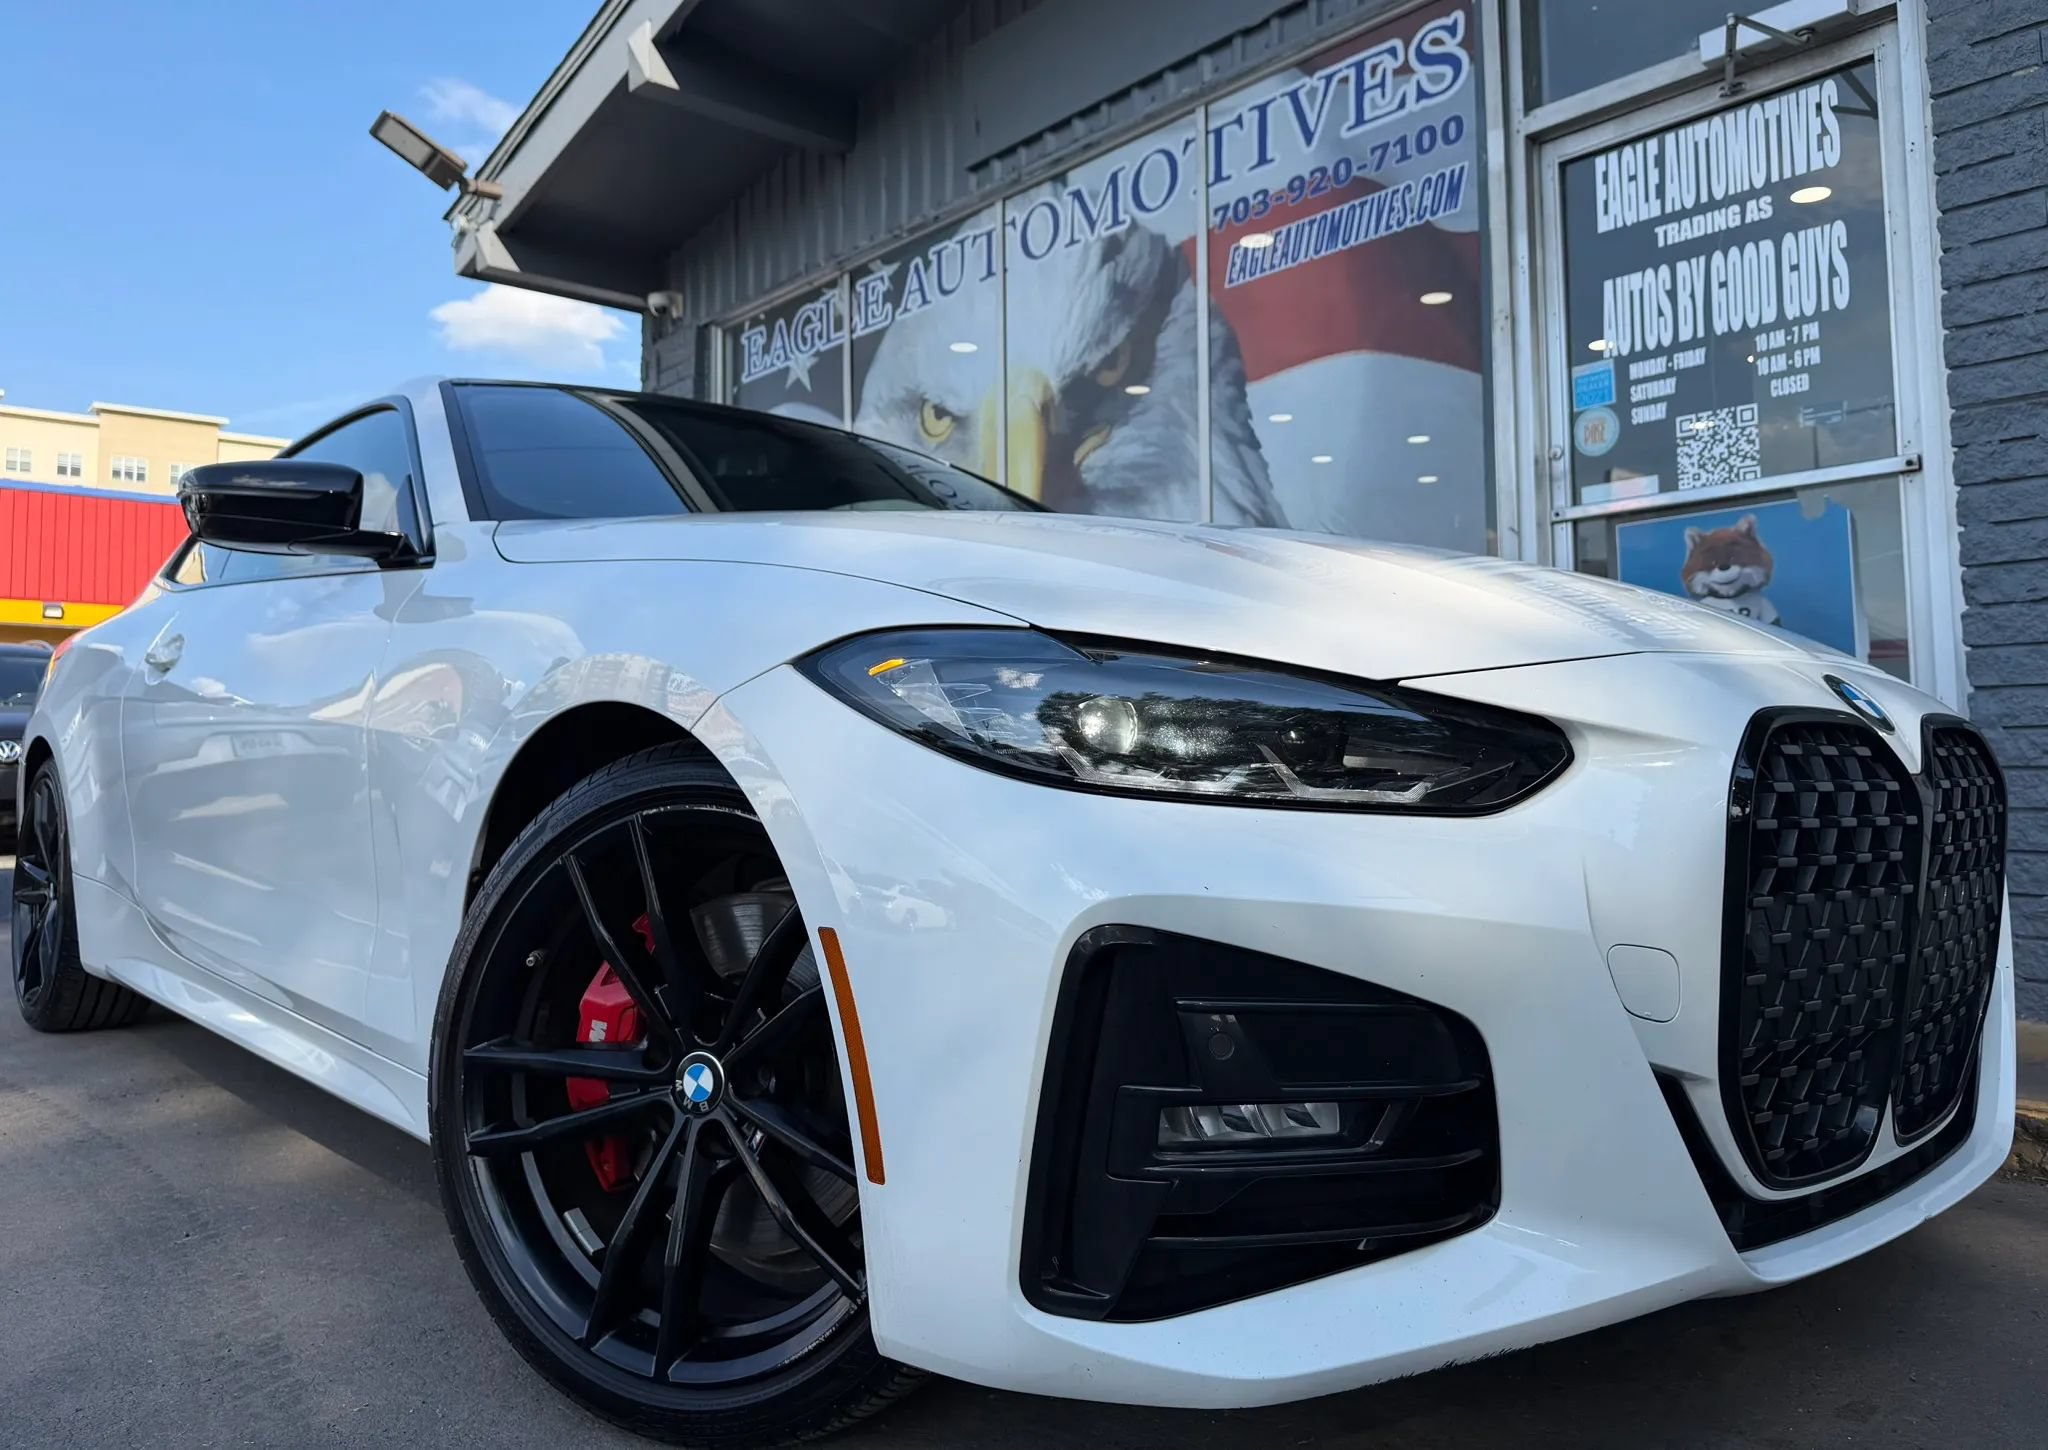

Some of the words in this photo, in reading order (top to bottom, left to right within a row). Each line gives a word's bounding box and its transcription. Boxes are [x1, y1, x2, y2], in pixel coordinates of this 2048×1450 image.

[1212, 114, 1465, 232] 703-920-7100
[1594, 137, 1661, 234] EAGLE
[1664, 79, 1841, 214] AUTOMOTIVES
[741, 271, 893, 382] EAGLE
[896, 10, 1469, 319] AUTOMOTIVES
[1225, 161, 1469, 288] EAGLEAUTOMOTIVES.COM
[1654, 204, 1741, 248] TRADING
[1745, 195, 1773, 224] AS
[1602, 263, 1674, 359] AUTOS
[1675, 254, 1706, 344] BY
[1710, 238, 1778, 336] GOOD
[1780, 219, 1850, 321] GUYS
[1755, 333, 1767, 352] 10
[1768, 329, 1785, 349] AM
[1792, 325, 1800, 345] 7
[1802, 321, 1820, 342] PM
[1628, 355, 1668, 380] MONDAY
[1672, 347, 1706, 371] FRIDAY
[1756, 357, 1769, 376] 10
[1770, 353, 1787, 373] AM
[1803, 346, 1821, 367] PM
[1629, 377, 1677, 403] SATURDAY
[1770, 373, 1810, 397] CLOSED
[1631, 402, 1667, 425] SUNDAY
